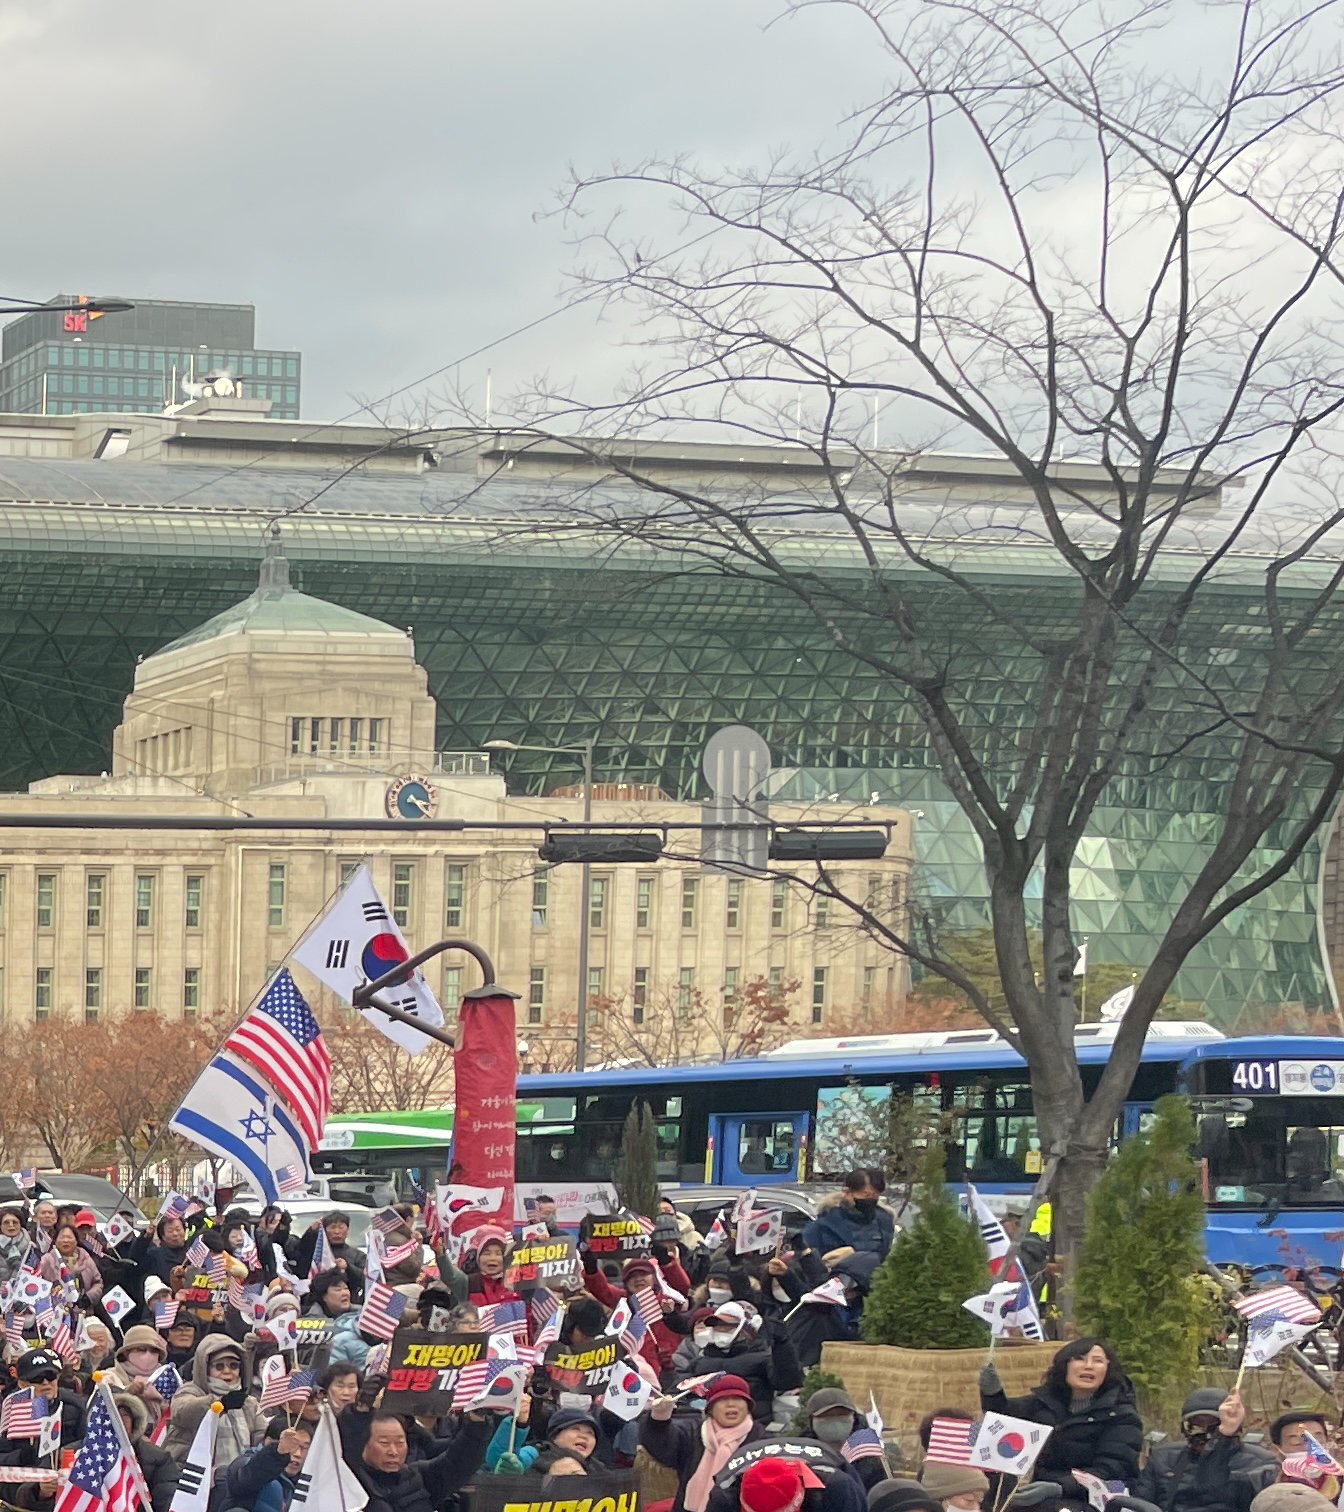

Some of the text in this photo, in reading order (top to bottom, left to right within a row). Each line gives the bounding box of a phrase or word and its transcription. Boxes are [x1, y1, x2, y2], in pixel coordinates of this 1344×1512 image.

[1233, 1062, 1276, 1090] 401
[511, 1244, 568, 1266] 재명아!
[538, 1259, 576, 1279] 가자!
[402, 1342, 482, 1366] 재명아!
[554, 1344, 616, 1370] 재명아!
[387, 1369, 438, 1391] 깜방
